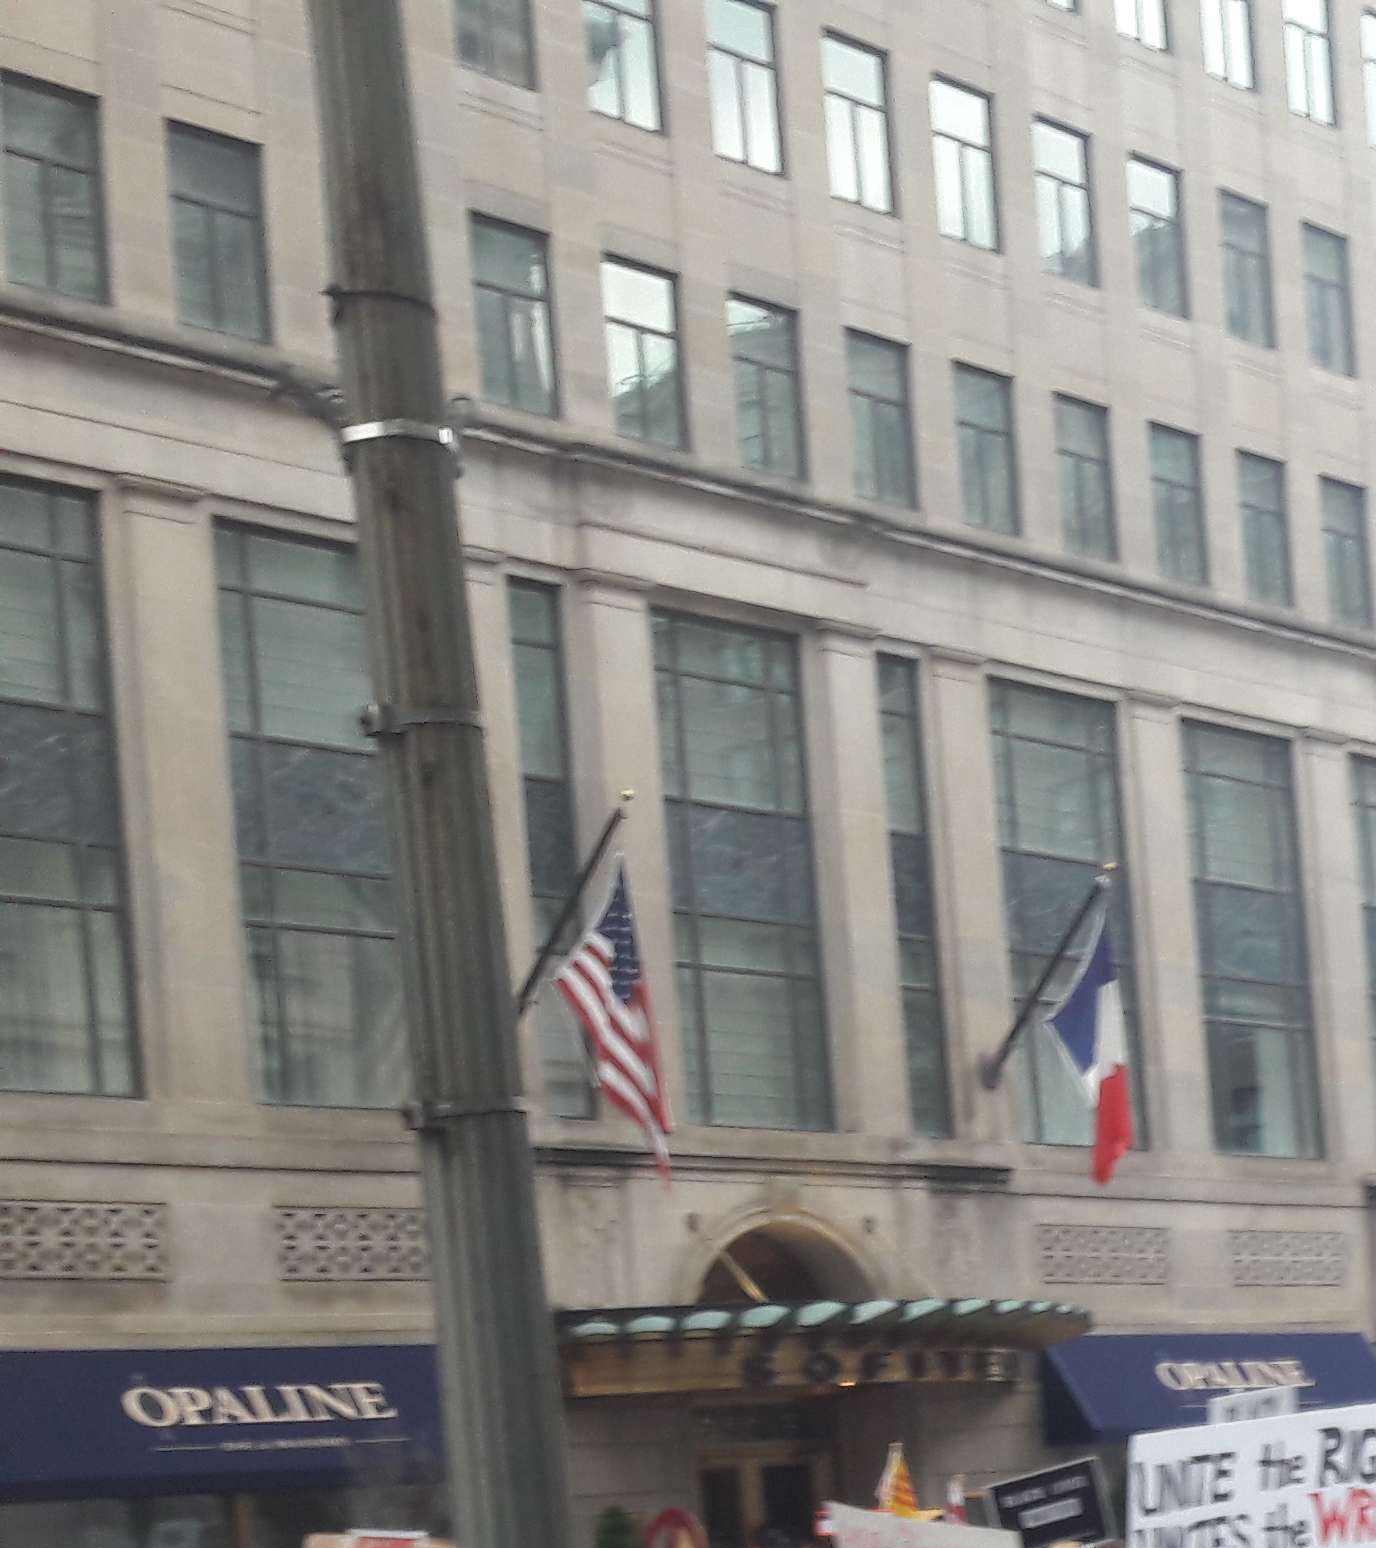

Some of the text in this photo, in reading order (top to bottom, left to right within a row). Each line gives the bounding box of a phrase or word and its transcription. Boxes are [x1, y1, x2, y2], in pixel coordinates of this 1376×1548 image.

[1155, 1360, 1317, 1391] OPALINE
[120, 1382, 398, 1428] OPALINE
[1132, 1450, 1237, 1517] UNITE
[1258, 1440, 1307, 1491] the
